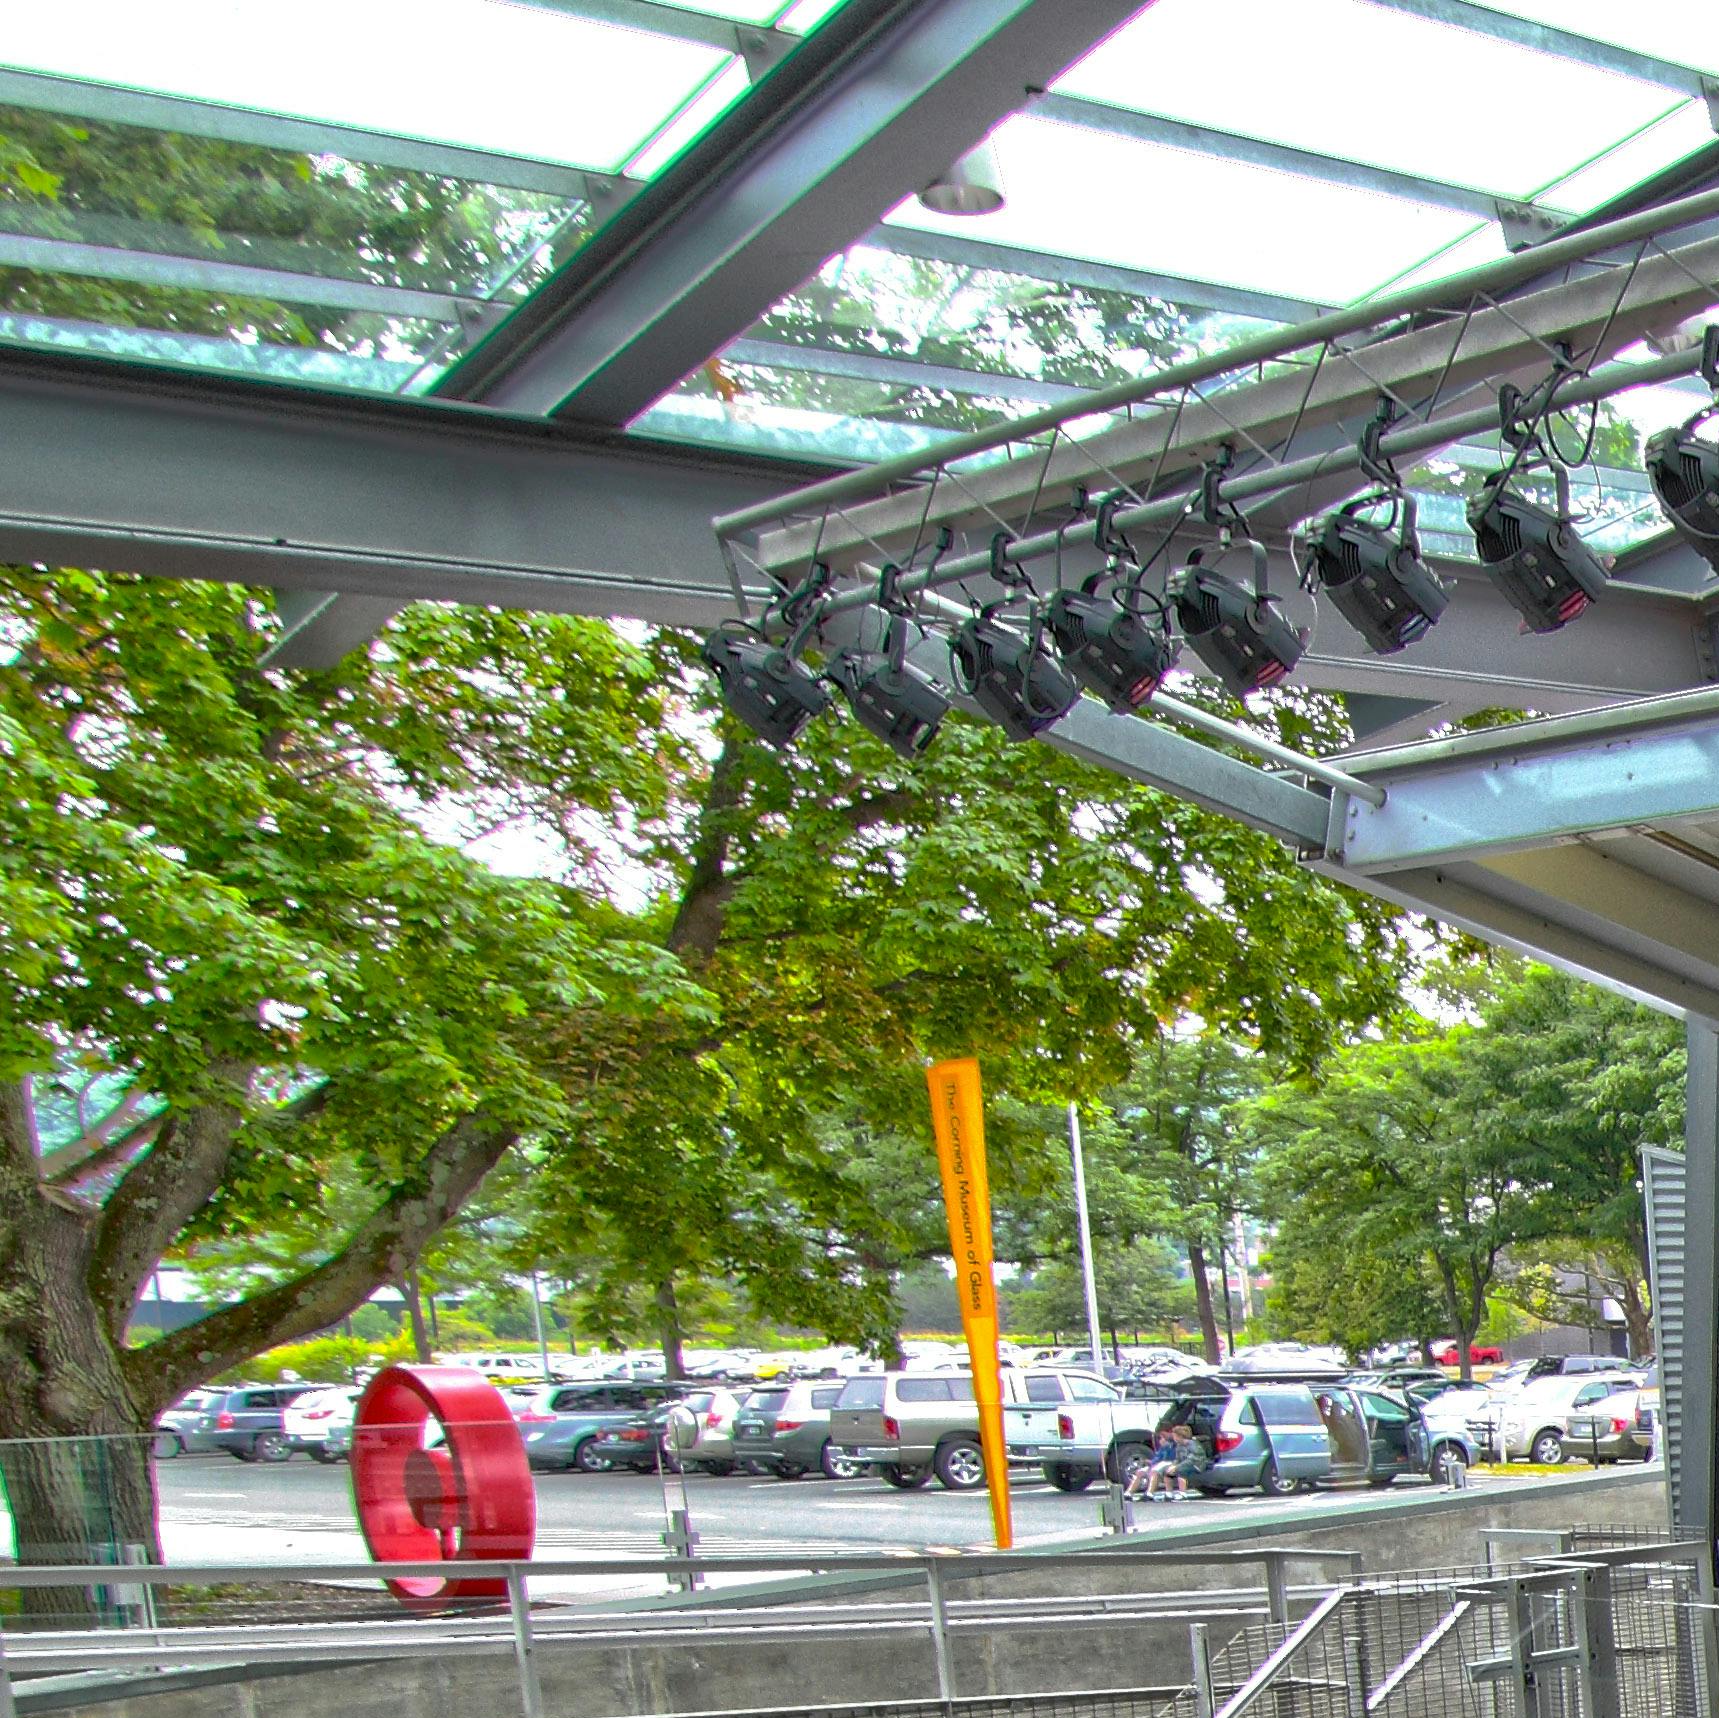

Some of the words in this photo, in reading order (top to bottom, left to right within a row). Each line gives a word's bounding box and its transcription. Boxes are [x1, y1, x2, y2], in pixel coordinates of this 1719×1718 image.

[945, 1082, 956, 1110] The
[950, 1114, 964, 1175] Corning
[959, 1180, 974, 1245] Museum
[967, 1249, 980, 1266] of
[969, 1271, 983, 1311] Glass
